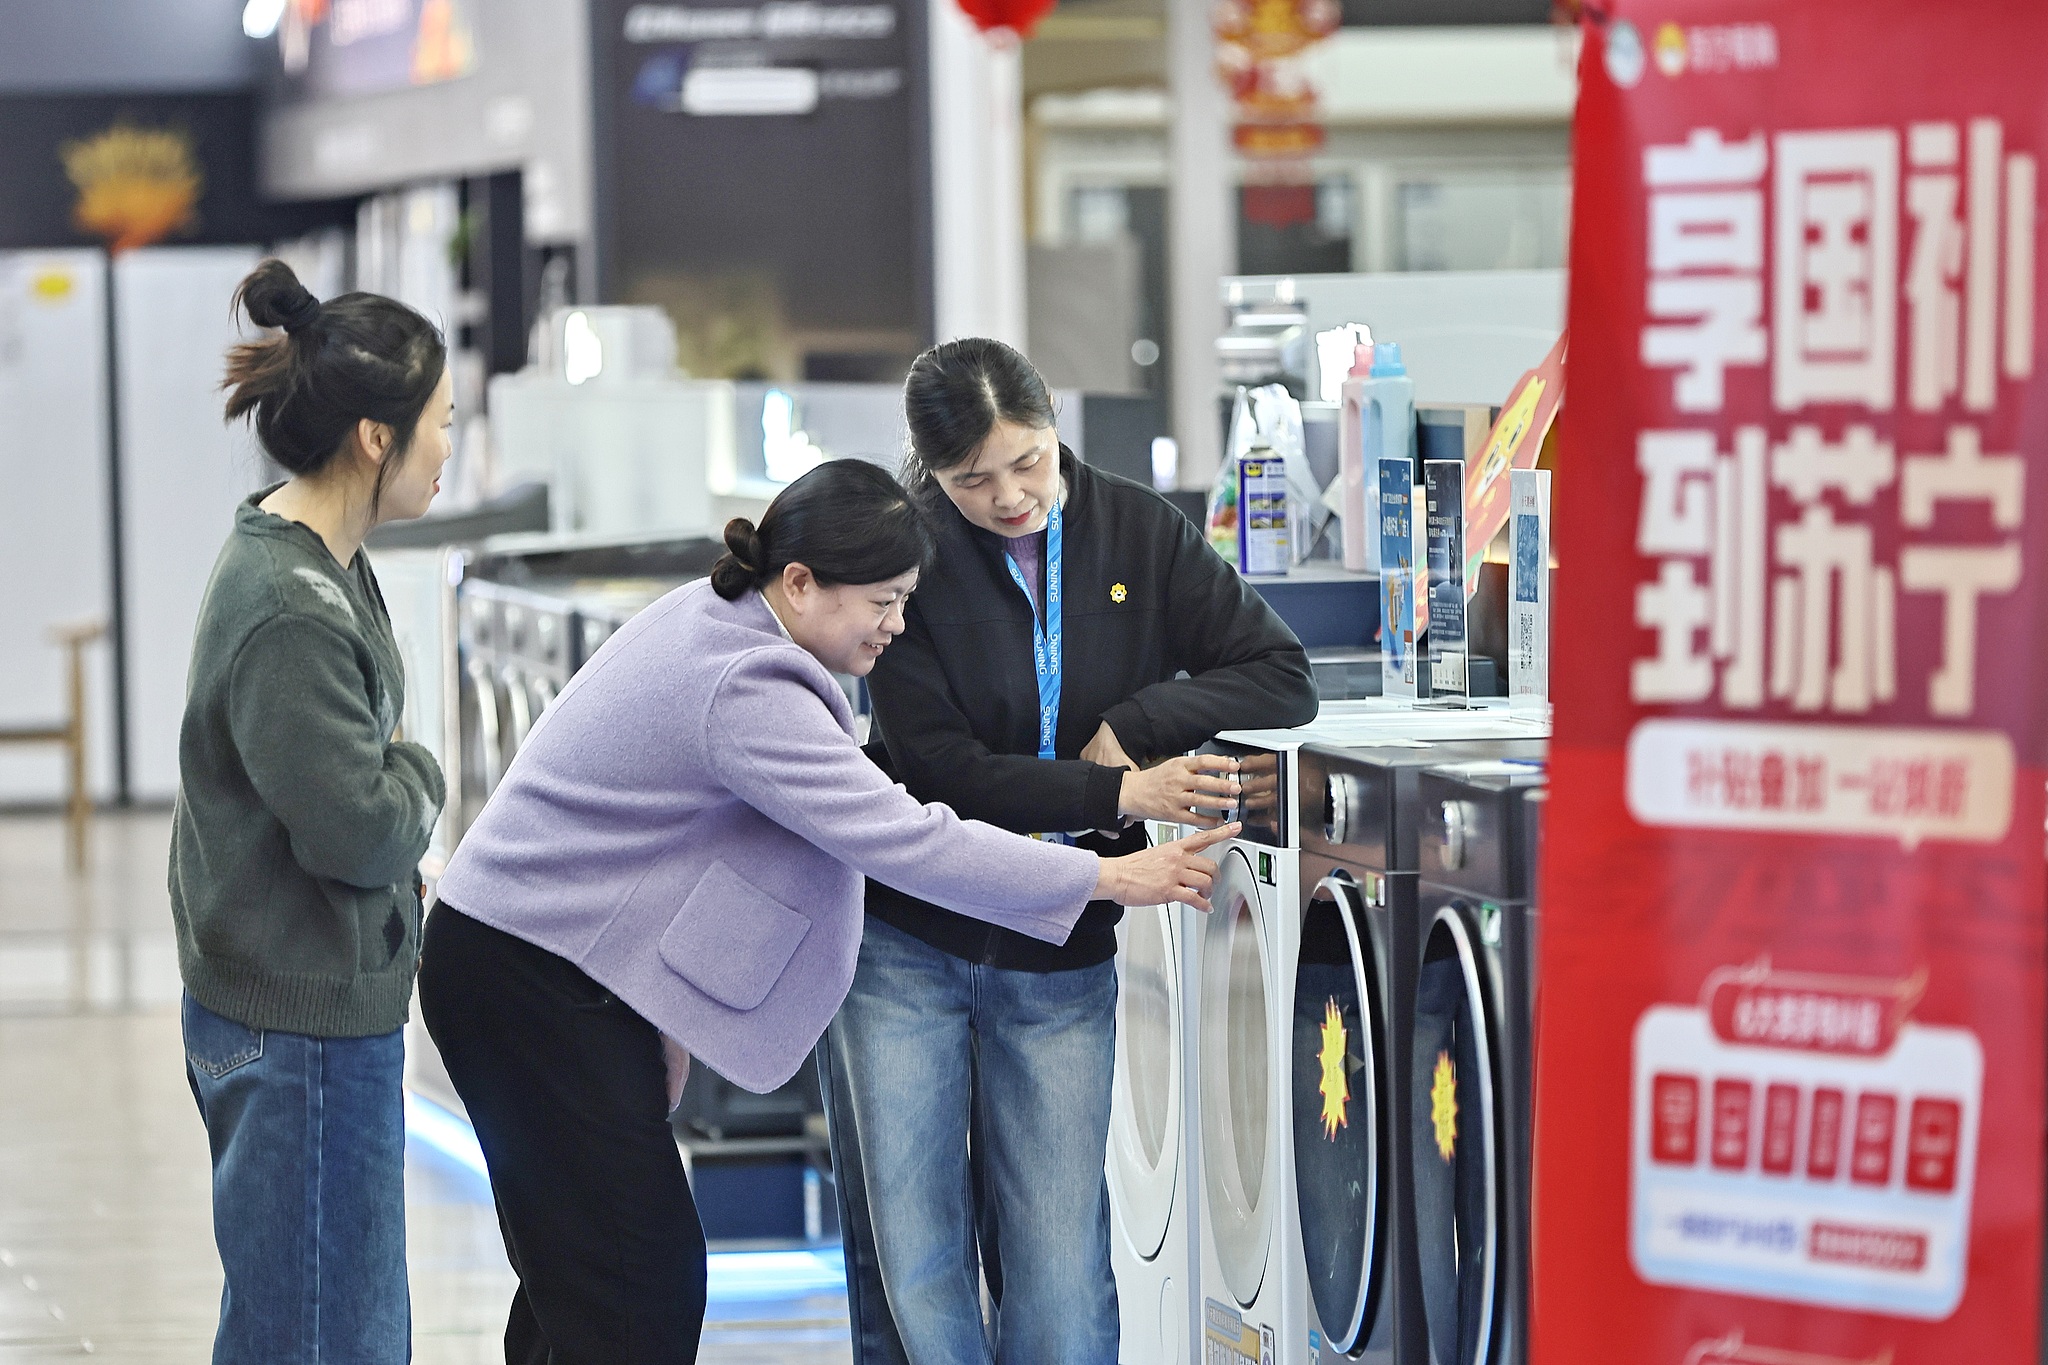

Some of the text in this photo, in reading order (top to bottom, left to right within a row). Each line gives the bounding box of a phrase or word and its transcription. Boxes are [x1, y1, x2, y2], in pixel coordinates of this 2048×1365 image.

[1050, 561, 1059, 603] SUNING
[1629, 424, 2026, 717] 到苏宁
[1050, 633, 1058, 675] SUNING
[1043, 705, 1051, 746] SUNING
